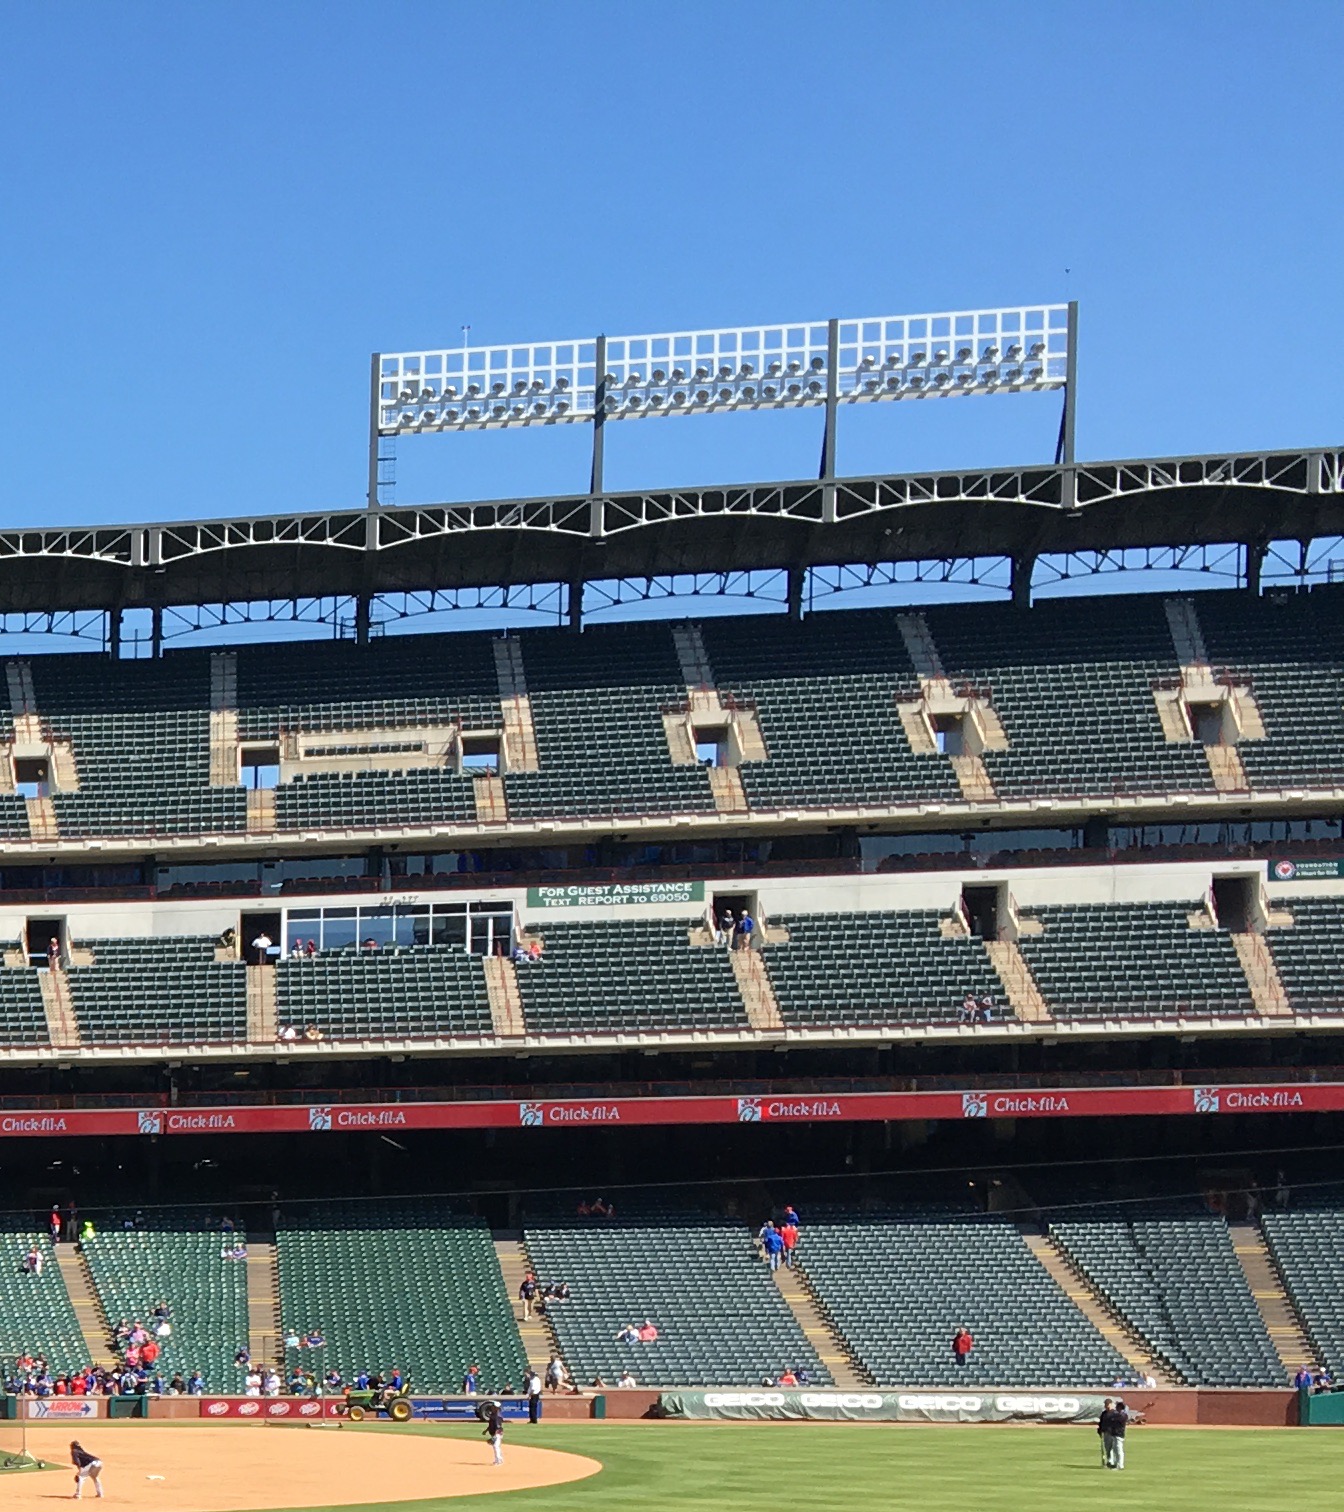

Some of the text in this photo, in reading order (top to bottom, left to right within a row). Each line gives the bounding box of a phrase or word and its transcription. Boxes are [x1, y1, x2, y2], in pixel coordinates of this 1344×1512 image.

[578, 895, 629, 906] REPORT
[650, 892, 690, 902] 69050
[994, 1096, 1069, 1112] Chick-fil-A
[1226, 1091, 1303, 1107] Chick-fil-A
[548, 1105, 620, 1121] Chick-fil-A
[768, 1101, 841, 1117] Chick-fil-A
[2, 1117, 67, 1131] Chick-fil-A
[168, 1113, 235, 1129] Chick-fil-A
[337, 1110, 406, 1125] Chick-fil-A
[704, 1393, 785, 1407] GEICO
[801, 1393, 883, 1408] GEICO
[899, 1395, 981, 1411] GEICO
[996, 1397, 1080, 1413] GEICO
